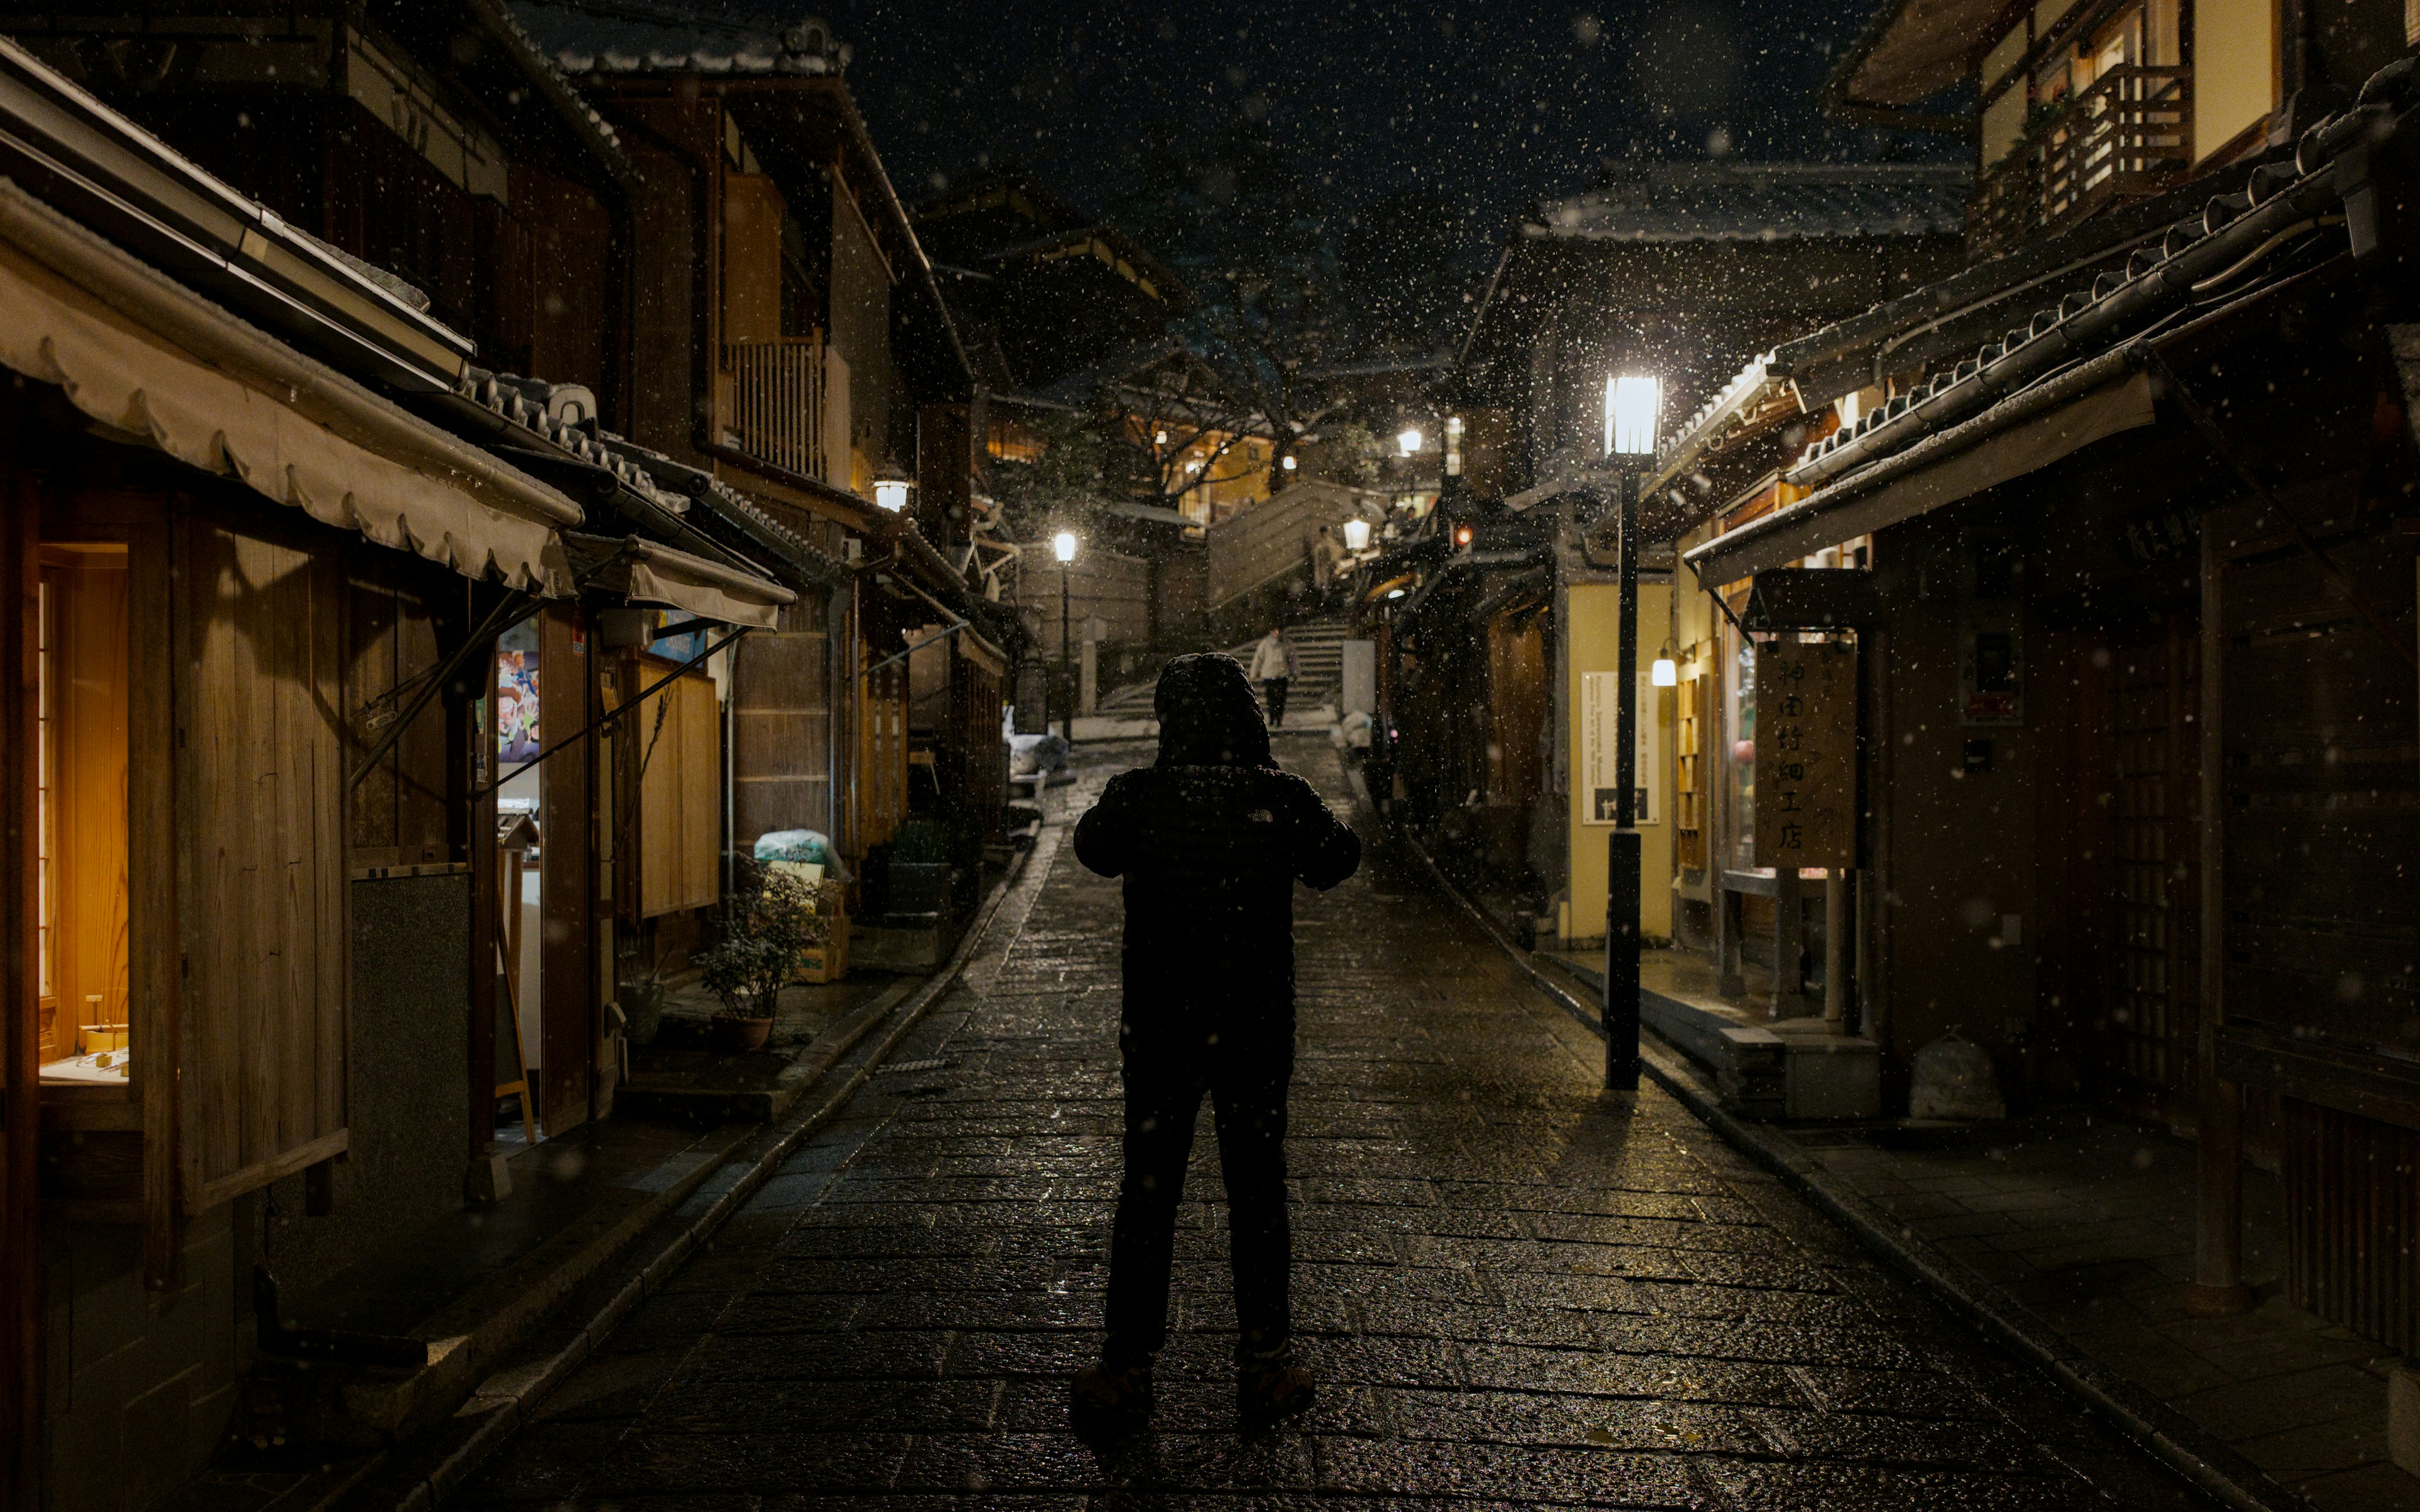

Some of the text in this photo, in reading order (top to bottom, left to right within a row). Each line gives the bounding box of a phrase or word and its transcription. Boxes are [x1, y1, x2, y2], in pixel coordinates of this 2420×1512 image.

[1778, 660, 1805, 849] 神田竹細工店
